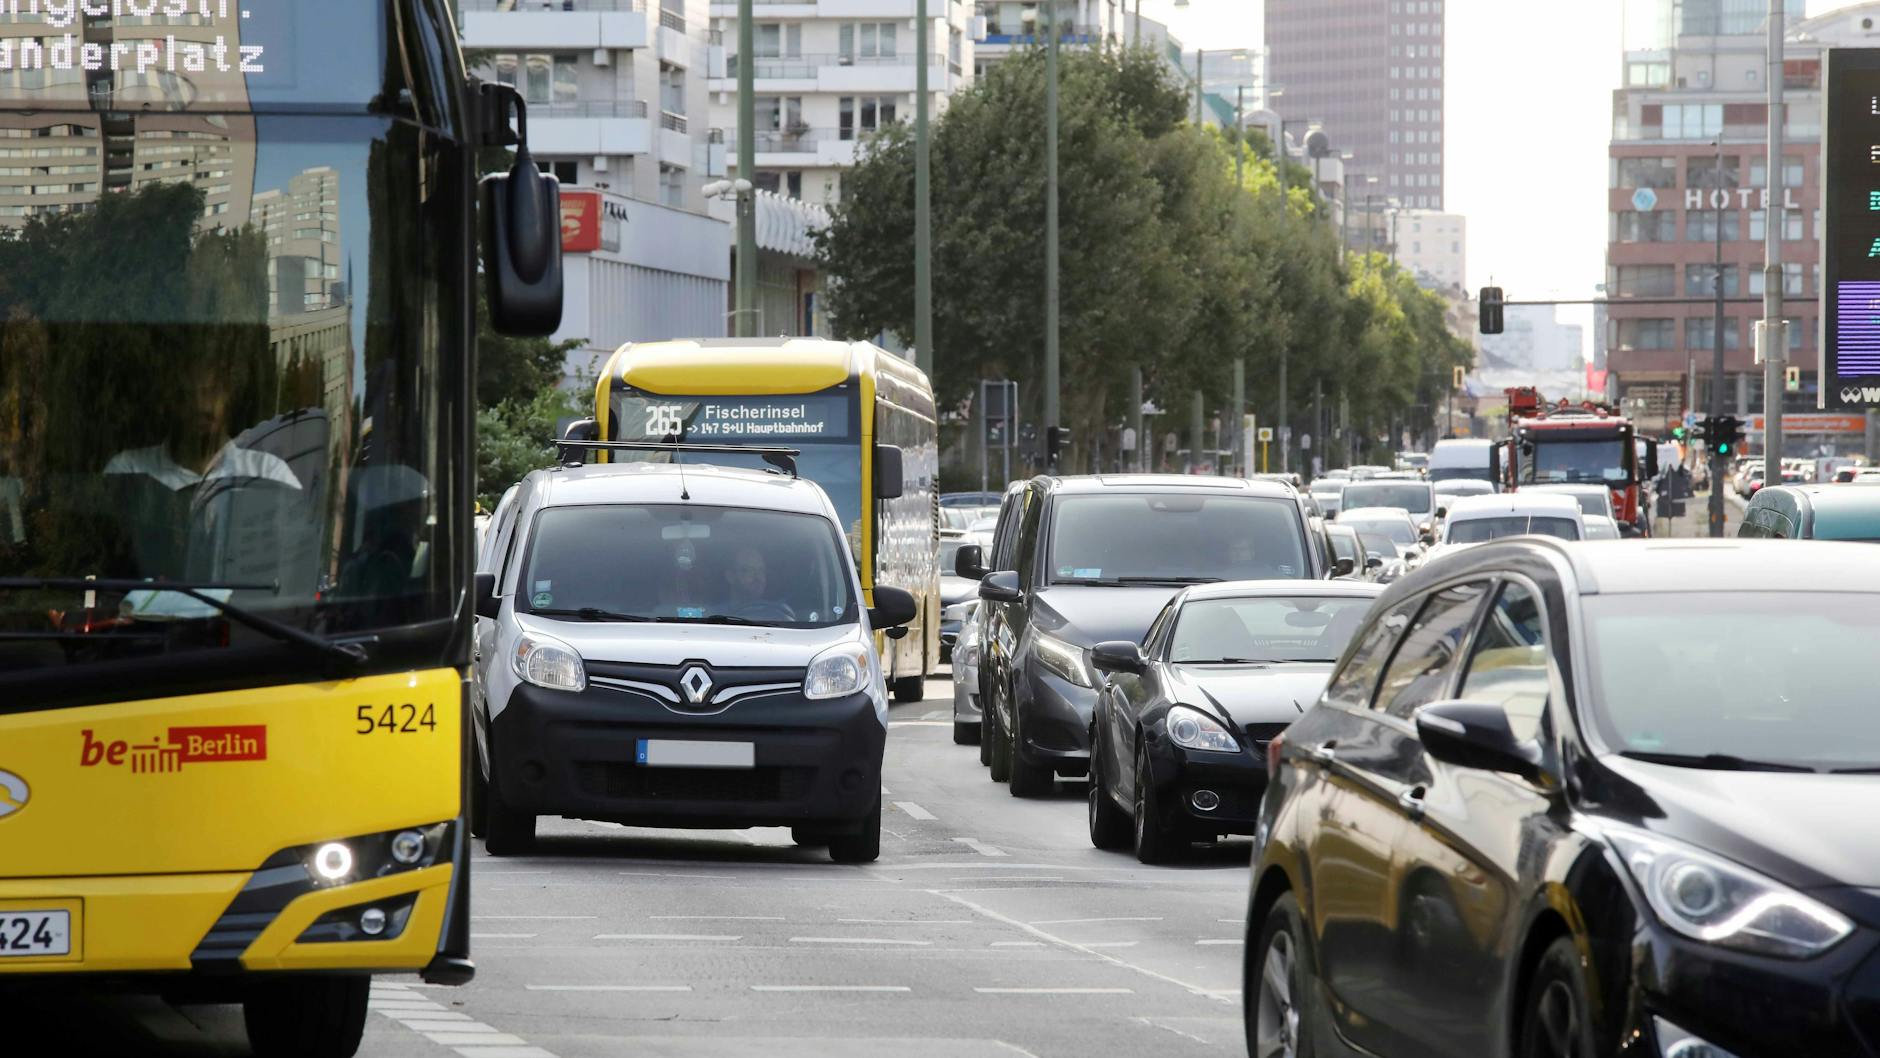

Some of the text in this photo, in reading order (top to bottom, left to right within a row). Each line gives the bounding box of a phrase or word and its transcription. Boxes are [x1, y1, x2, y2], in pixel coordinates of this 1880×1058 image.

[1685, 188, 1799, 209] HOTEL
[645, 406, 682, 436] 265
[705, 405, 805, 419] Fischerinsel
[701, 421, 824, 434] 147 S+U Hauptbahnhof
[356, 703, 437, 734] 5424
[187, 735, 258, 756] Berlin
